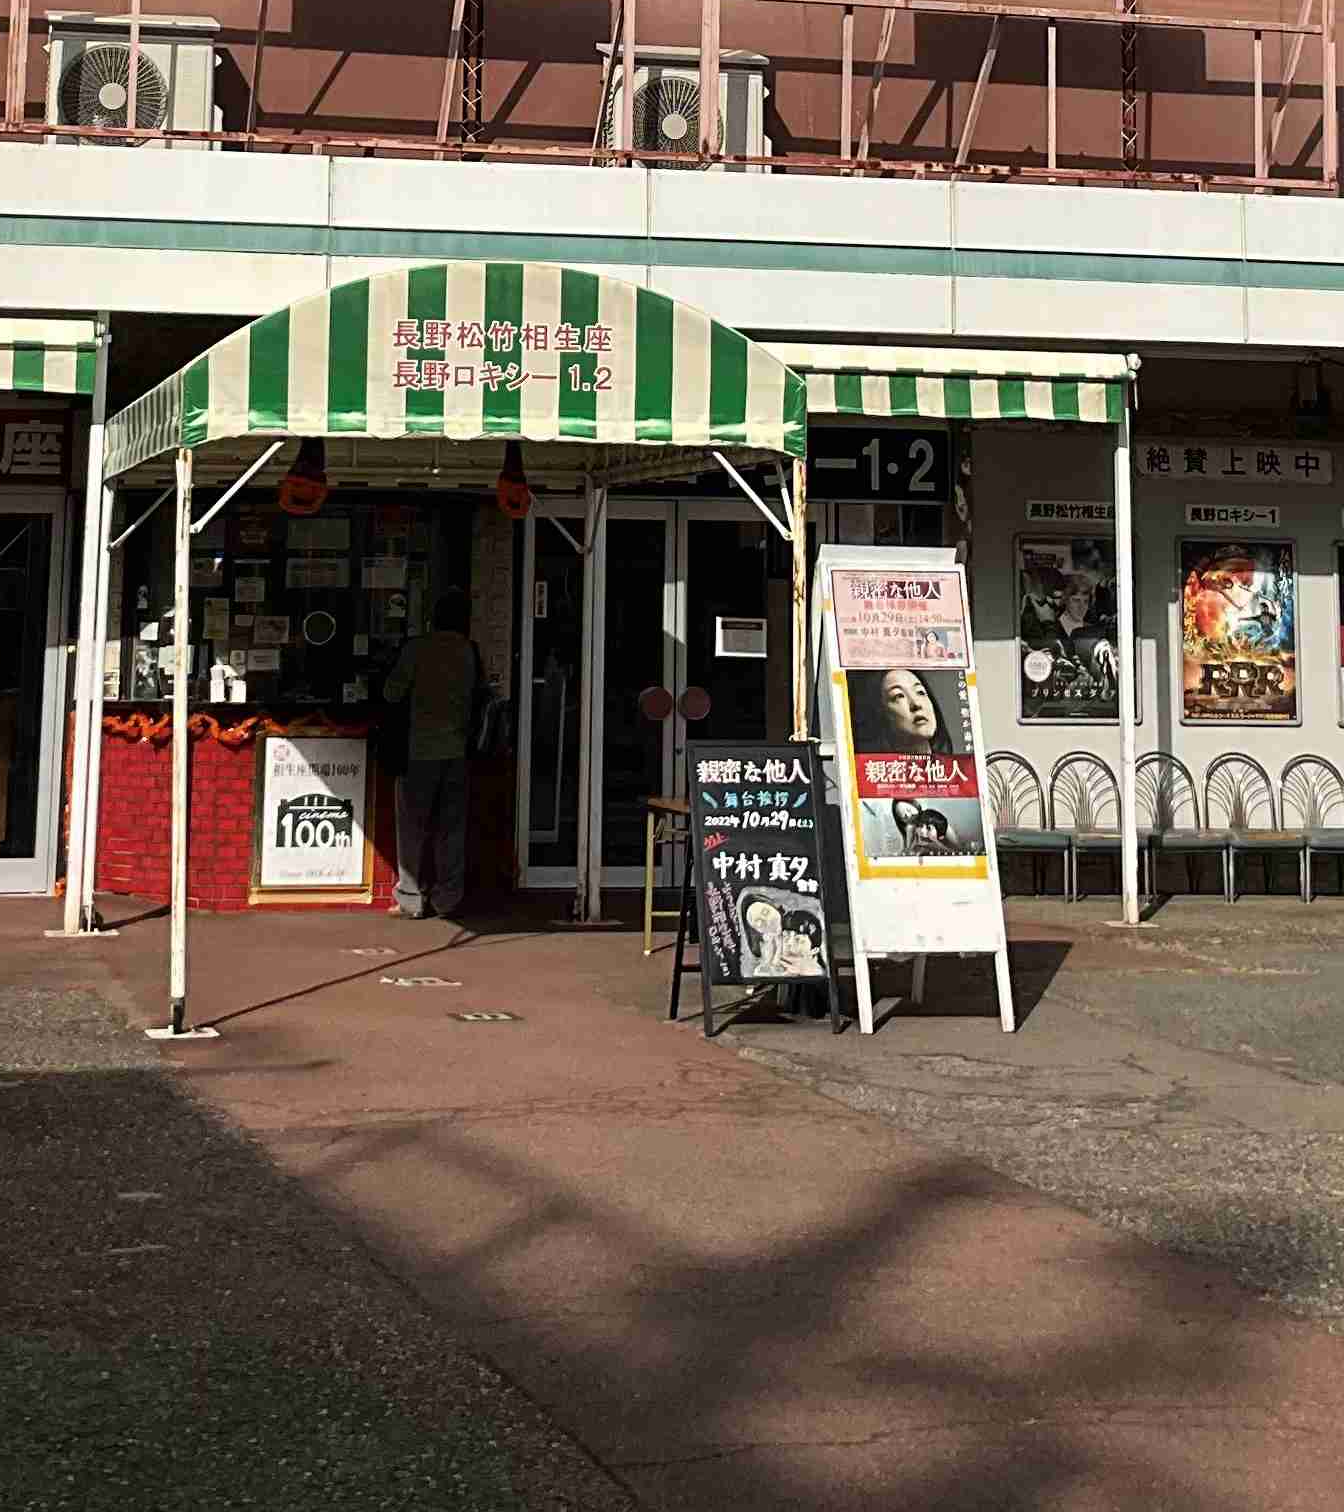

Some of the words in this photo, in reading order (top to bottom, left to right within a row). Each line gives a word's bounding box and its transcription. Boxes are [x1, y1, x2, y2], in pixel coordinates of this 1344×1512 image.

[392, 320, 614, 352] 長野松竹相生座
[1146, 447, 1320, 478] 絶賛上映中
[696, 759, 810, 784] 親密な他人
[864, 759, 969, 783] 親密な他人
